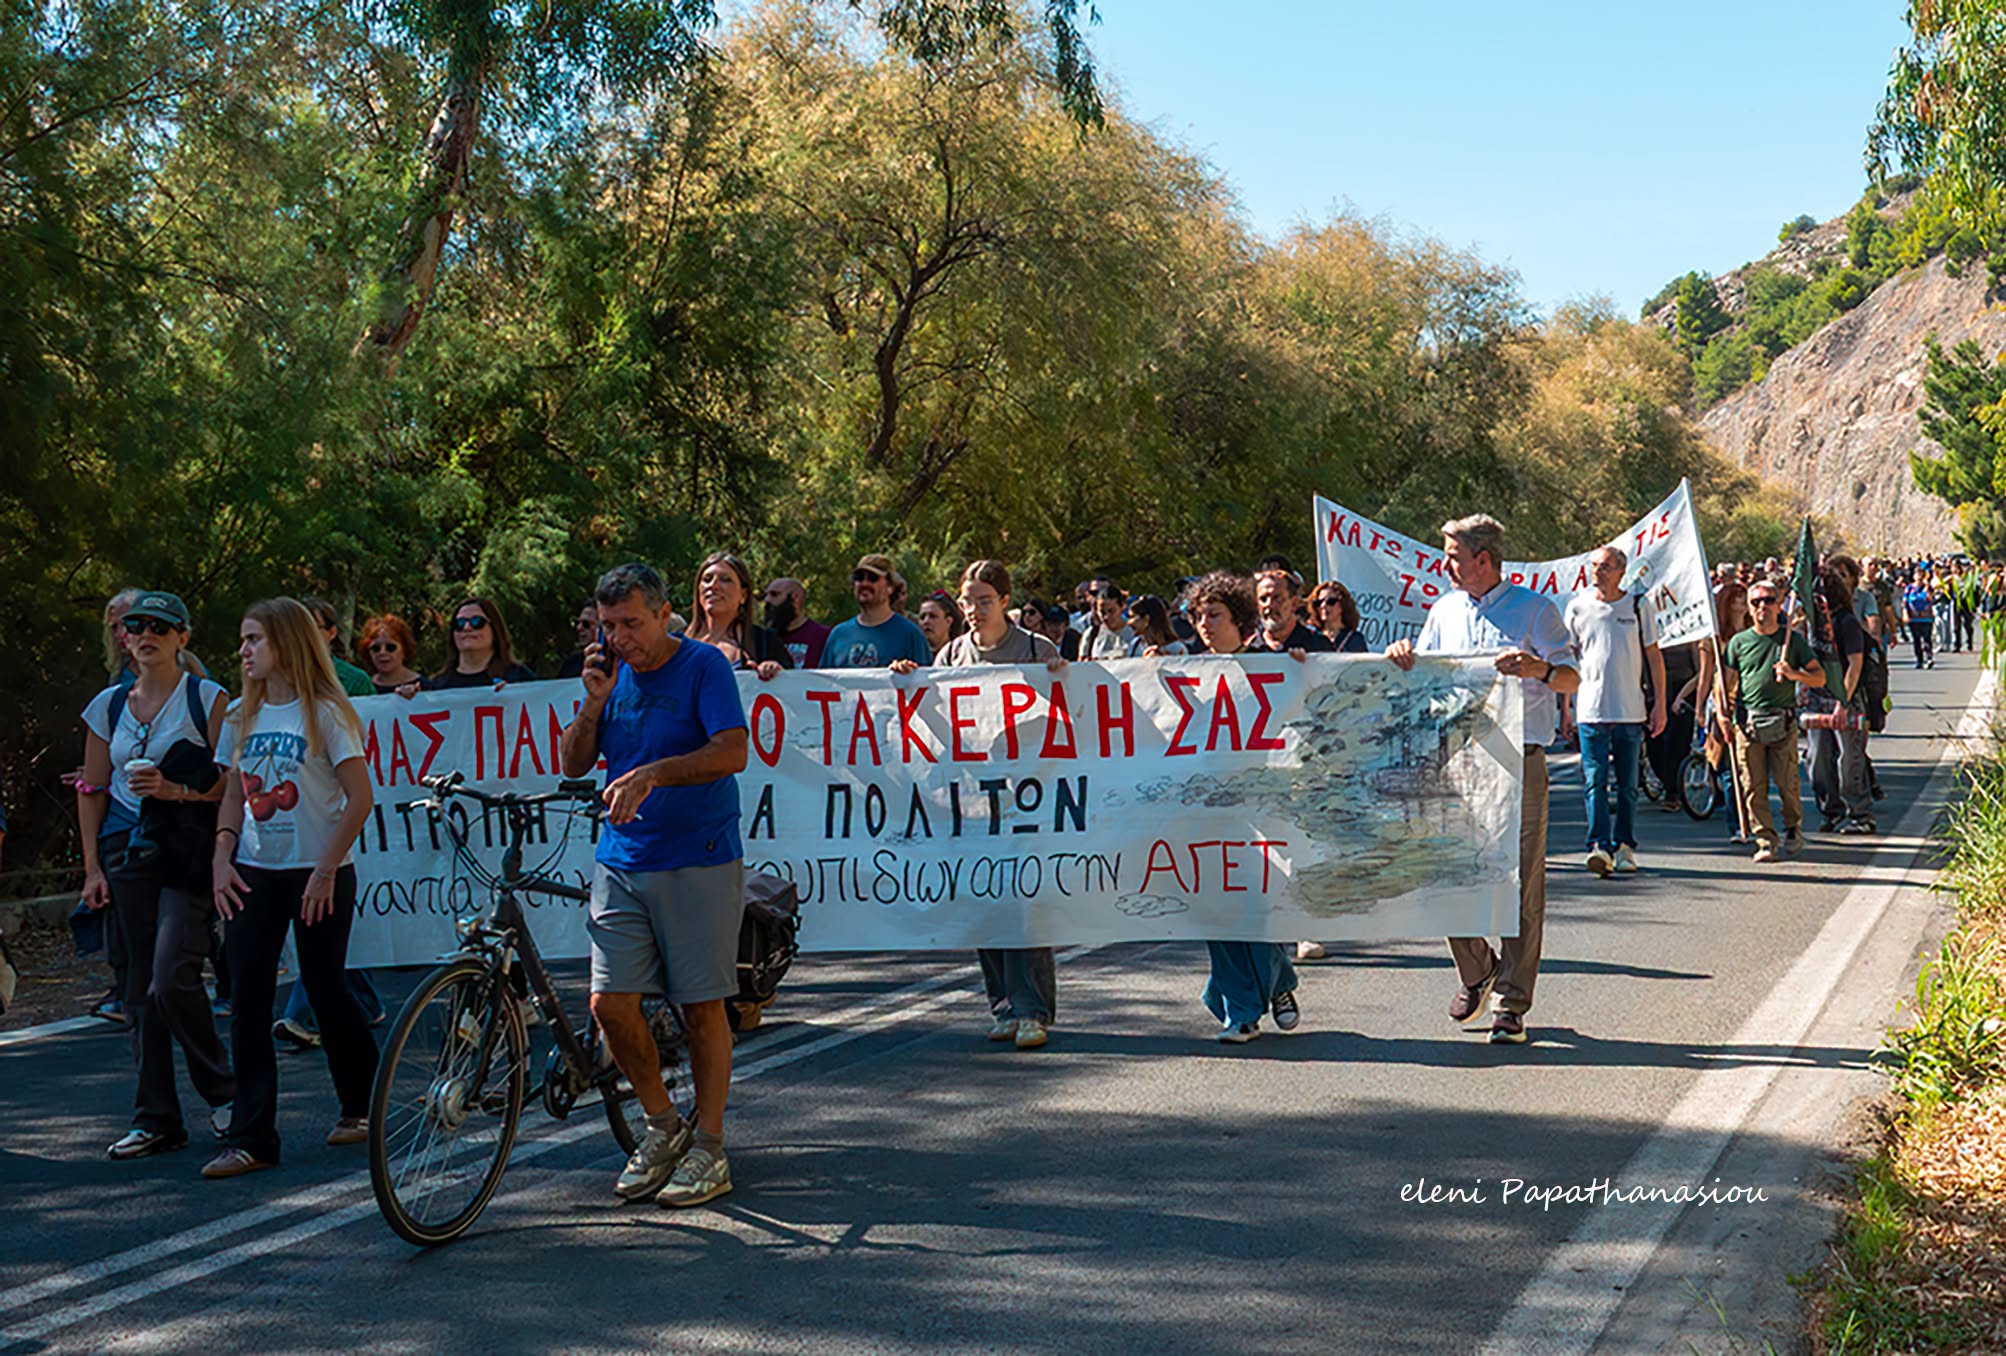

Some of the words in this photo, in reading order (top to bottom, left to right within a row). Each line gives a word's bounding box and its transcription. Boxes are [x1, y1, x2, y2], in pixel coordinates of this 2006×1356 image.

[1327, 511, 1402, 559] ΚΑΤΩ
[1415, 550, 1443, 577] ΤΑ
[1636, 510, 1671, 556] ΤΙΣ
[1398, 574, 1440, 610] ΖΩ
[474, 699, 607, 781] ΠΑΝ
[1163, 672, 1287, 757] ΣΑΣ
[360, 799, 548, 854] ΙΤΡΟΠΗ
[825, 774, 1088, 839] ΠΟΛΙΤΩΝ
[355, 874, 483, 918] ναντια
[1139, 839, 1288, 894] ΑΓΕΤ
